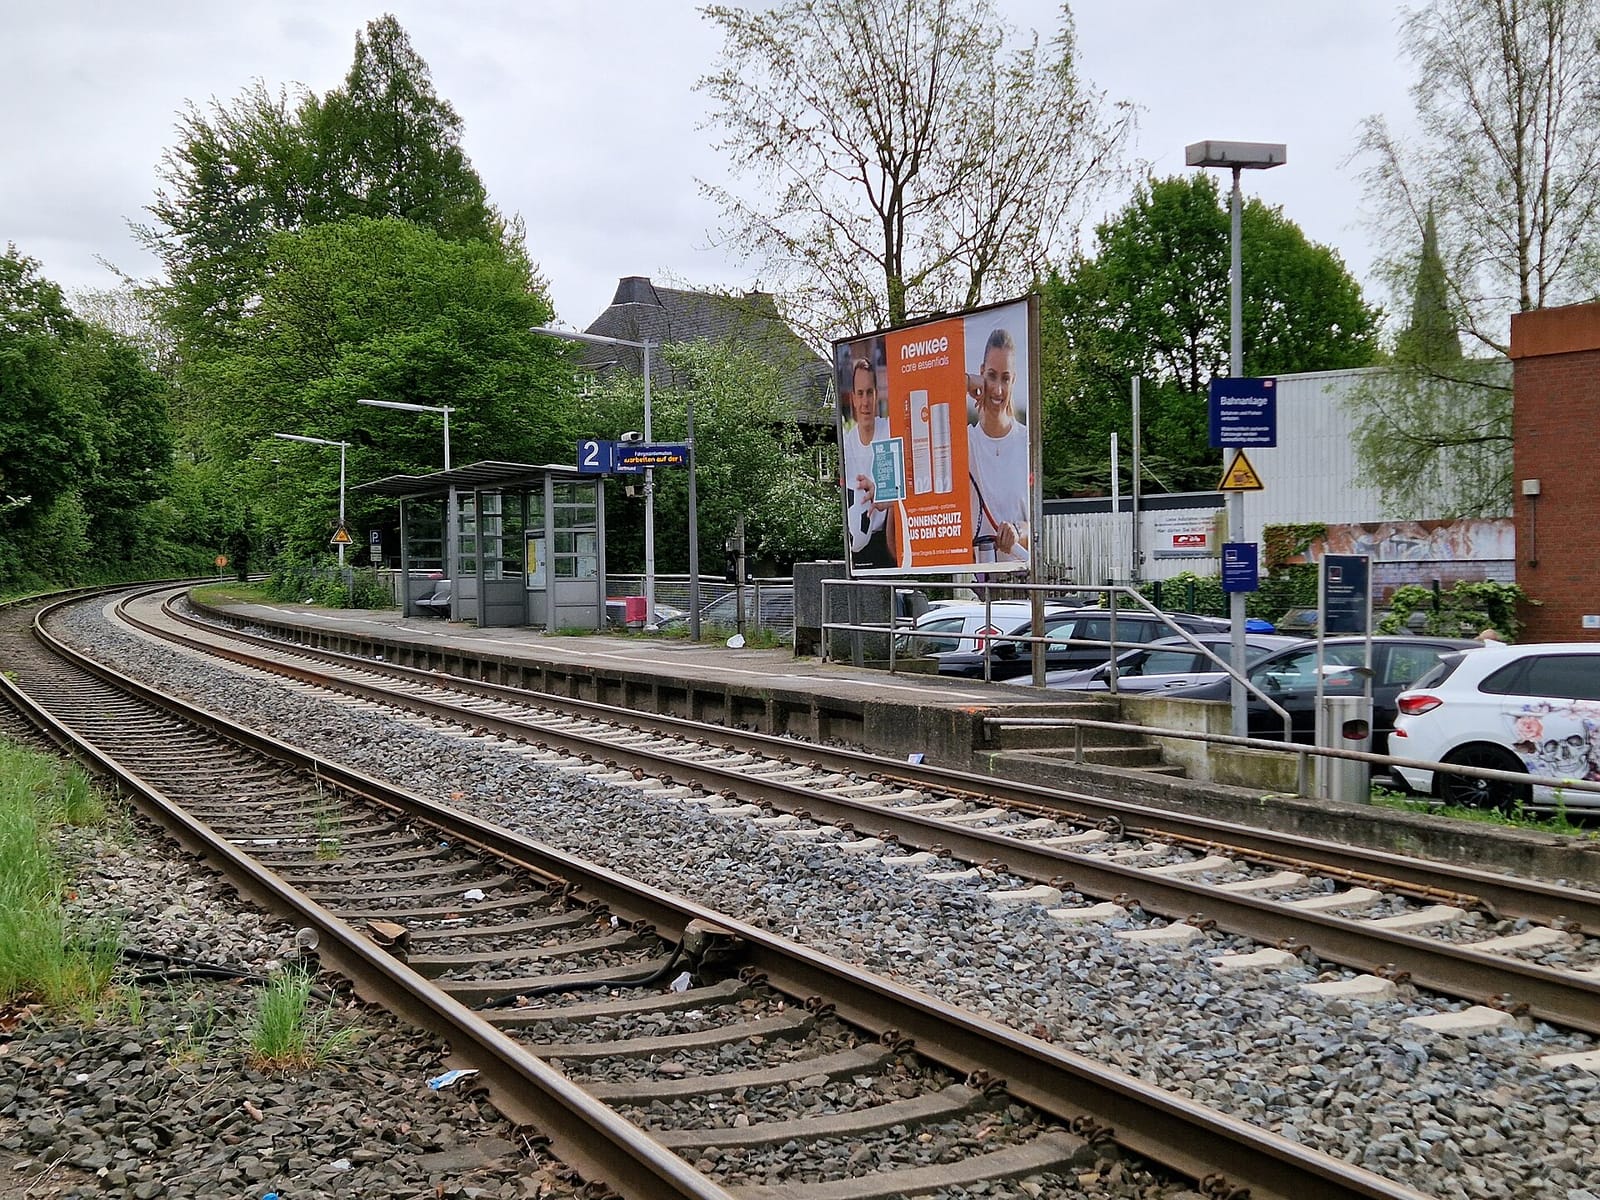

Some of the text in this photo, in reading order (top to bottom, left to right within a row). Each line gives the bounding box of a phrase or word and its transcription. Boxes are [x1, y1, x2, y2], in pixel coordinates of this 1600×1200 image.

[901, 336, 948, 360] newkee
[901, 355, 950, 374] care essentials
[1220, 396, 1268, 407] Bahnanlage
[583, 441, 599, 466] 2
[908, 512, 961, 528] ONNENSCHUTZ
[372, 532, 379, 543] P
[920, 526, 937, 540] DEM
[937, 525, 961, 538] SPORT
